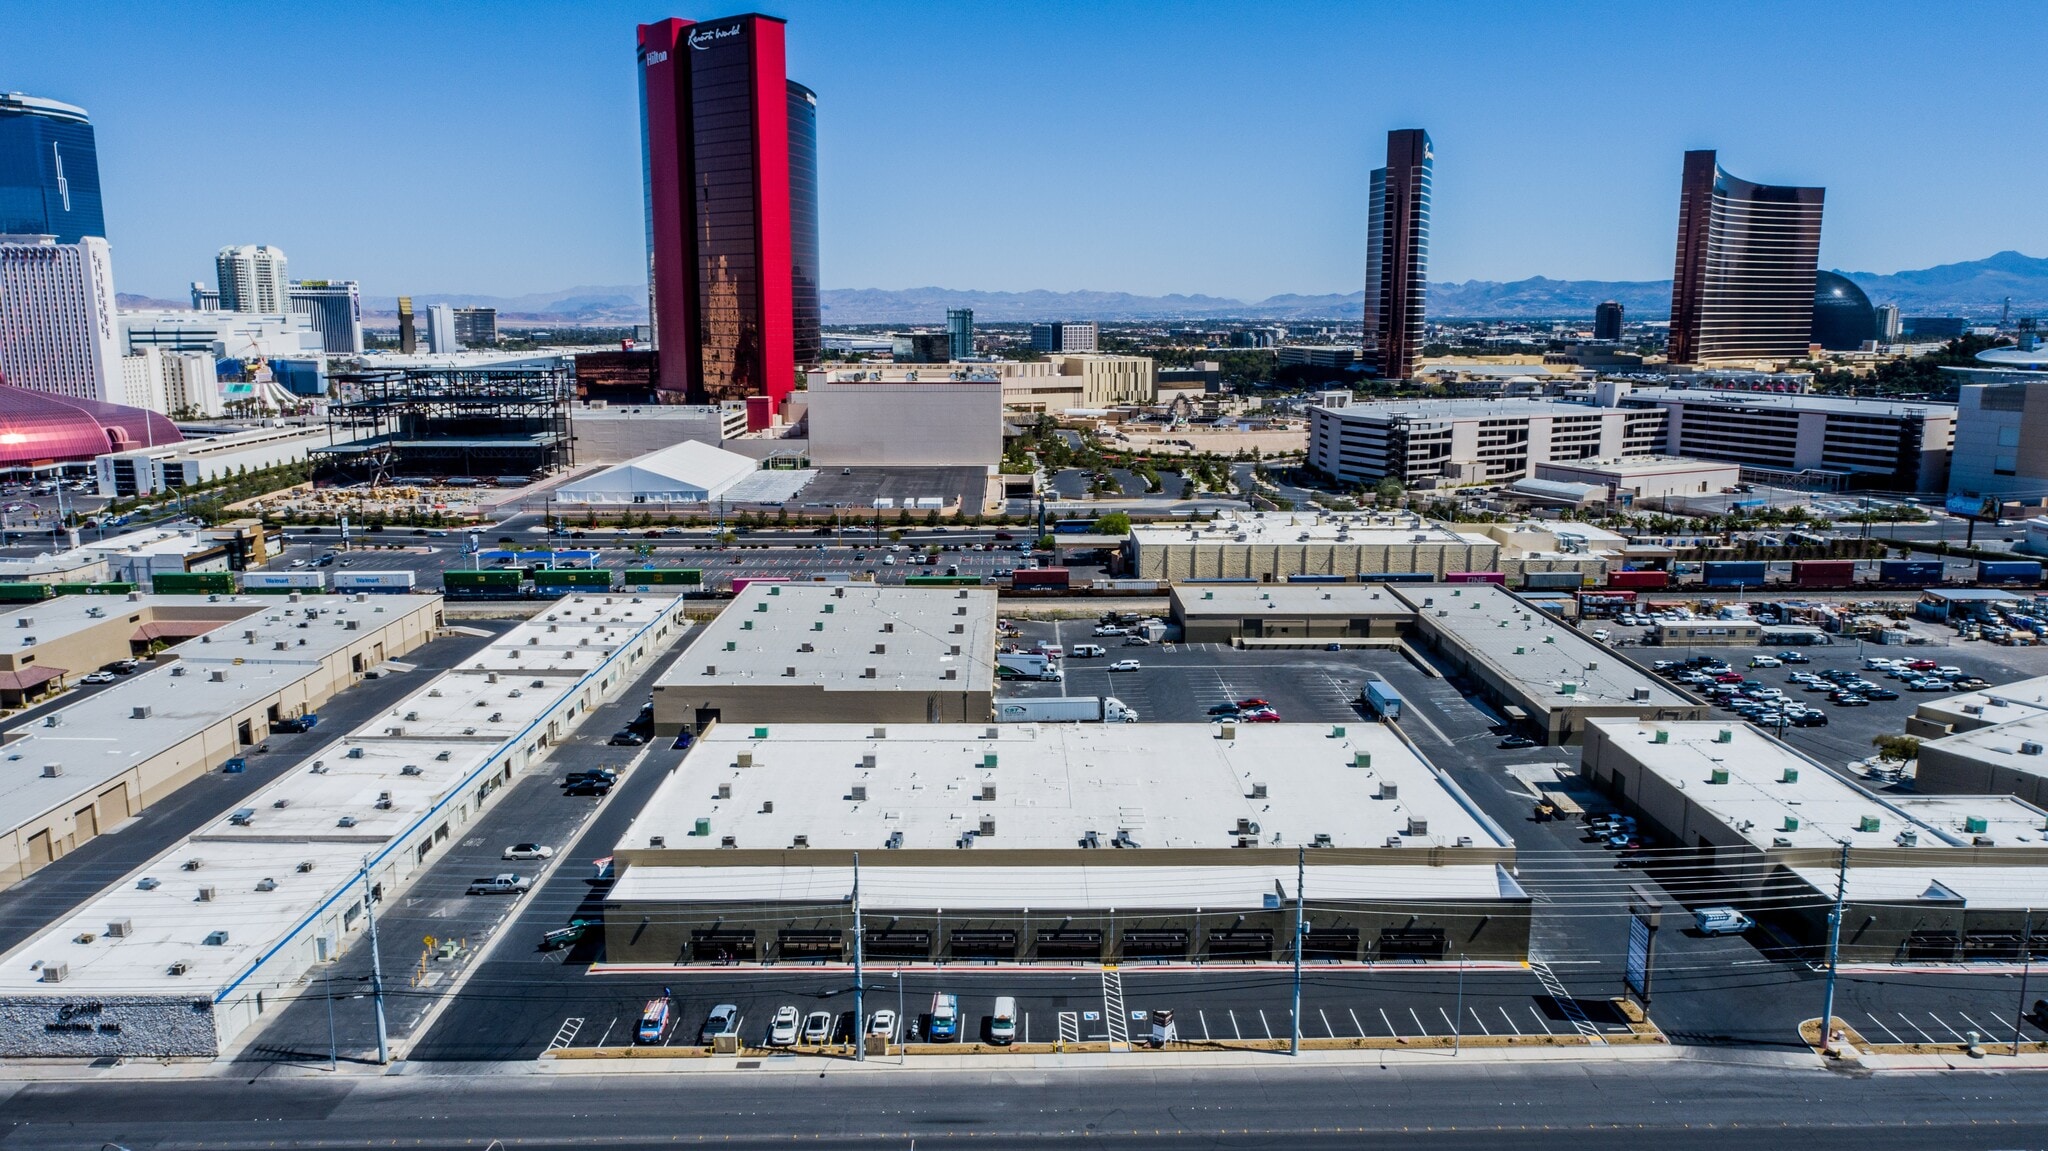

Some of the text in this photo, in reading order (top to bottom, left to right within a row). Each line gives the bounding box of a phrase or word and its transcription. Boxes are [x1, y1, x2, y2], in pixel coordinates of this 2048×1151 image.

[688, 24, 740, 50] Resorts World
[646, 50, 668, 67] Hilton
